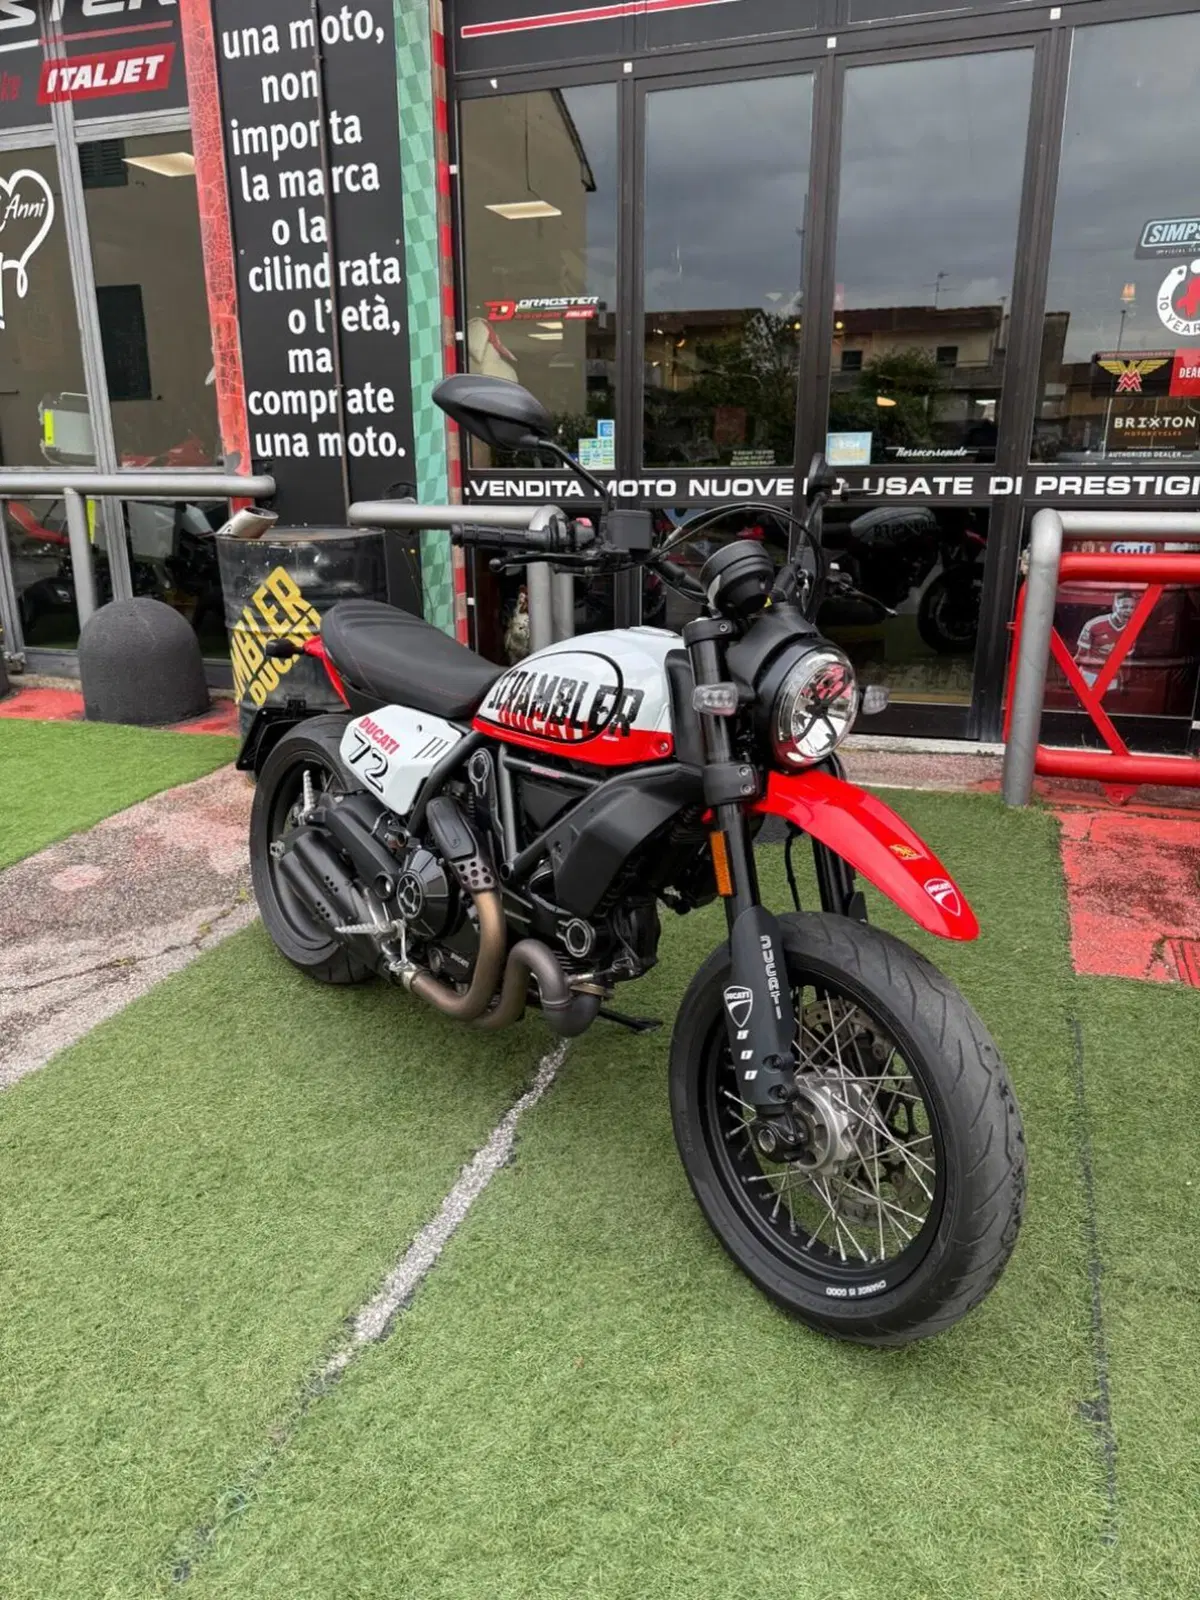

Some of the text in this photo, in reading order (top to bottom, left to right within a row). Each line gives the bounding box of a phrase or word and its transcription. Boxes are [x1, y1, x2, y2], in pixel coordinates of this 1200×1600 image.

[222, 5, 385, 59] una moto,
[46, 54, 166, 93] ITALJET
[261, 68, 319, 104] non
[230, 110, 363, 162] importa
[240, 162, 381, 202] la marca
[4, 193, 46, 219] Anni
[271, 207, 328, 245] o la
[248, 251, 401, 292] cilindrata
[287, 308, 306, 335] o
[287, 346, 334, 374] ma
[248, 381, 395, 423] comprate
[255, 426, 406, 458] una moto.
[1114, 416, 1197, 429] BRIXTON
[470, 480, 585, 497] VENDITA
[594, 479, 677, 497] MOTO
[688, 478, 795, 497] NUOVE
[862, 476, 974, 496] USATE
[988, 476, 1023, 496] DI
[231, 566, 314, 705] MBLER
[358, 715, 401, 756] DUCATI
[348, 726, 389, 794] 72
[760, 934, 782, 1020] DUCATI
